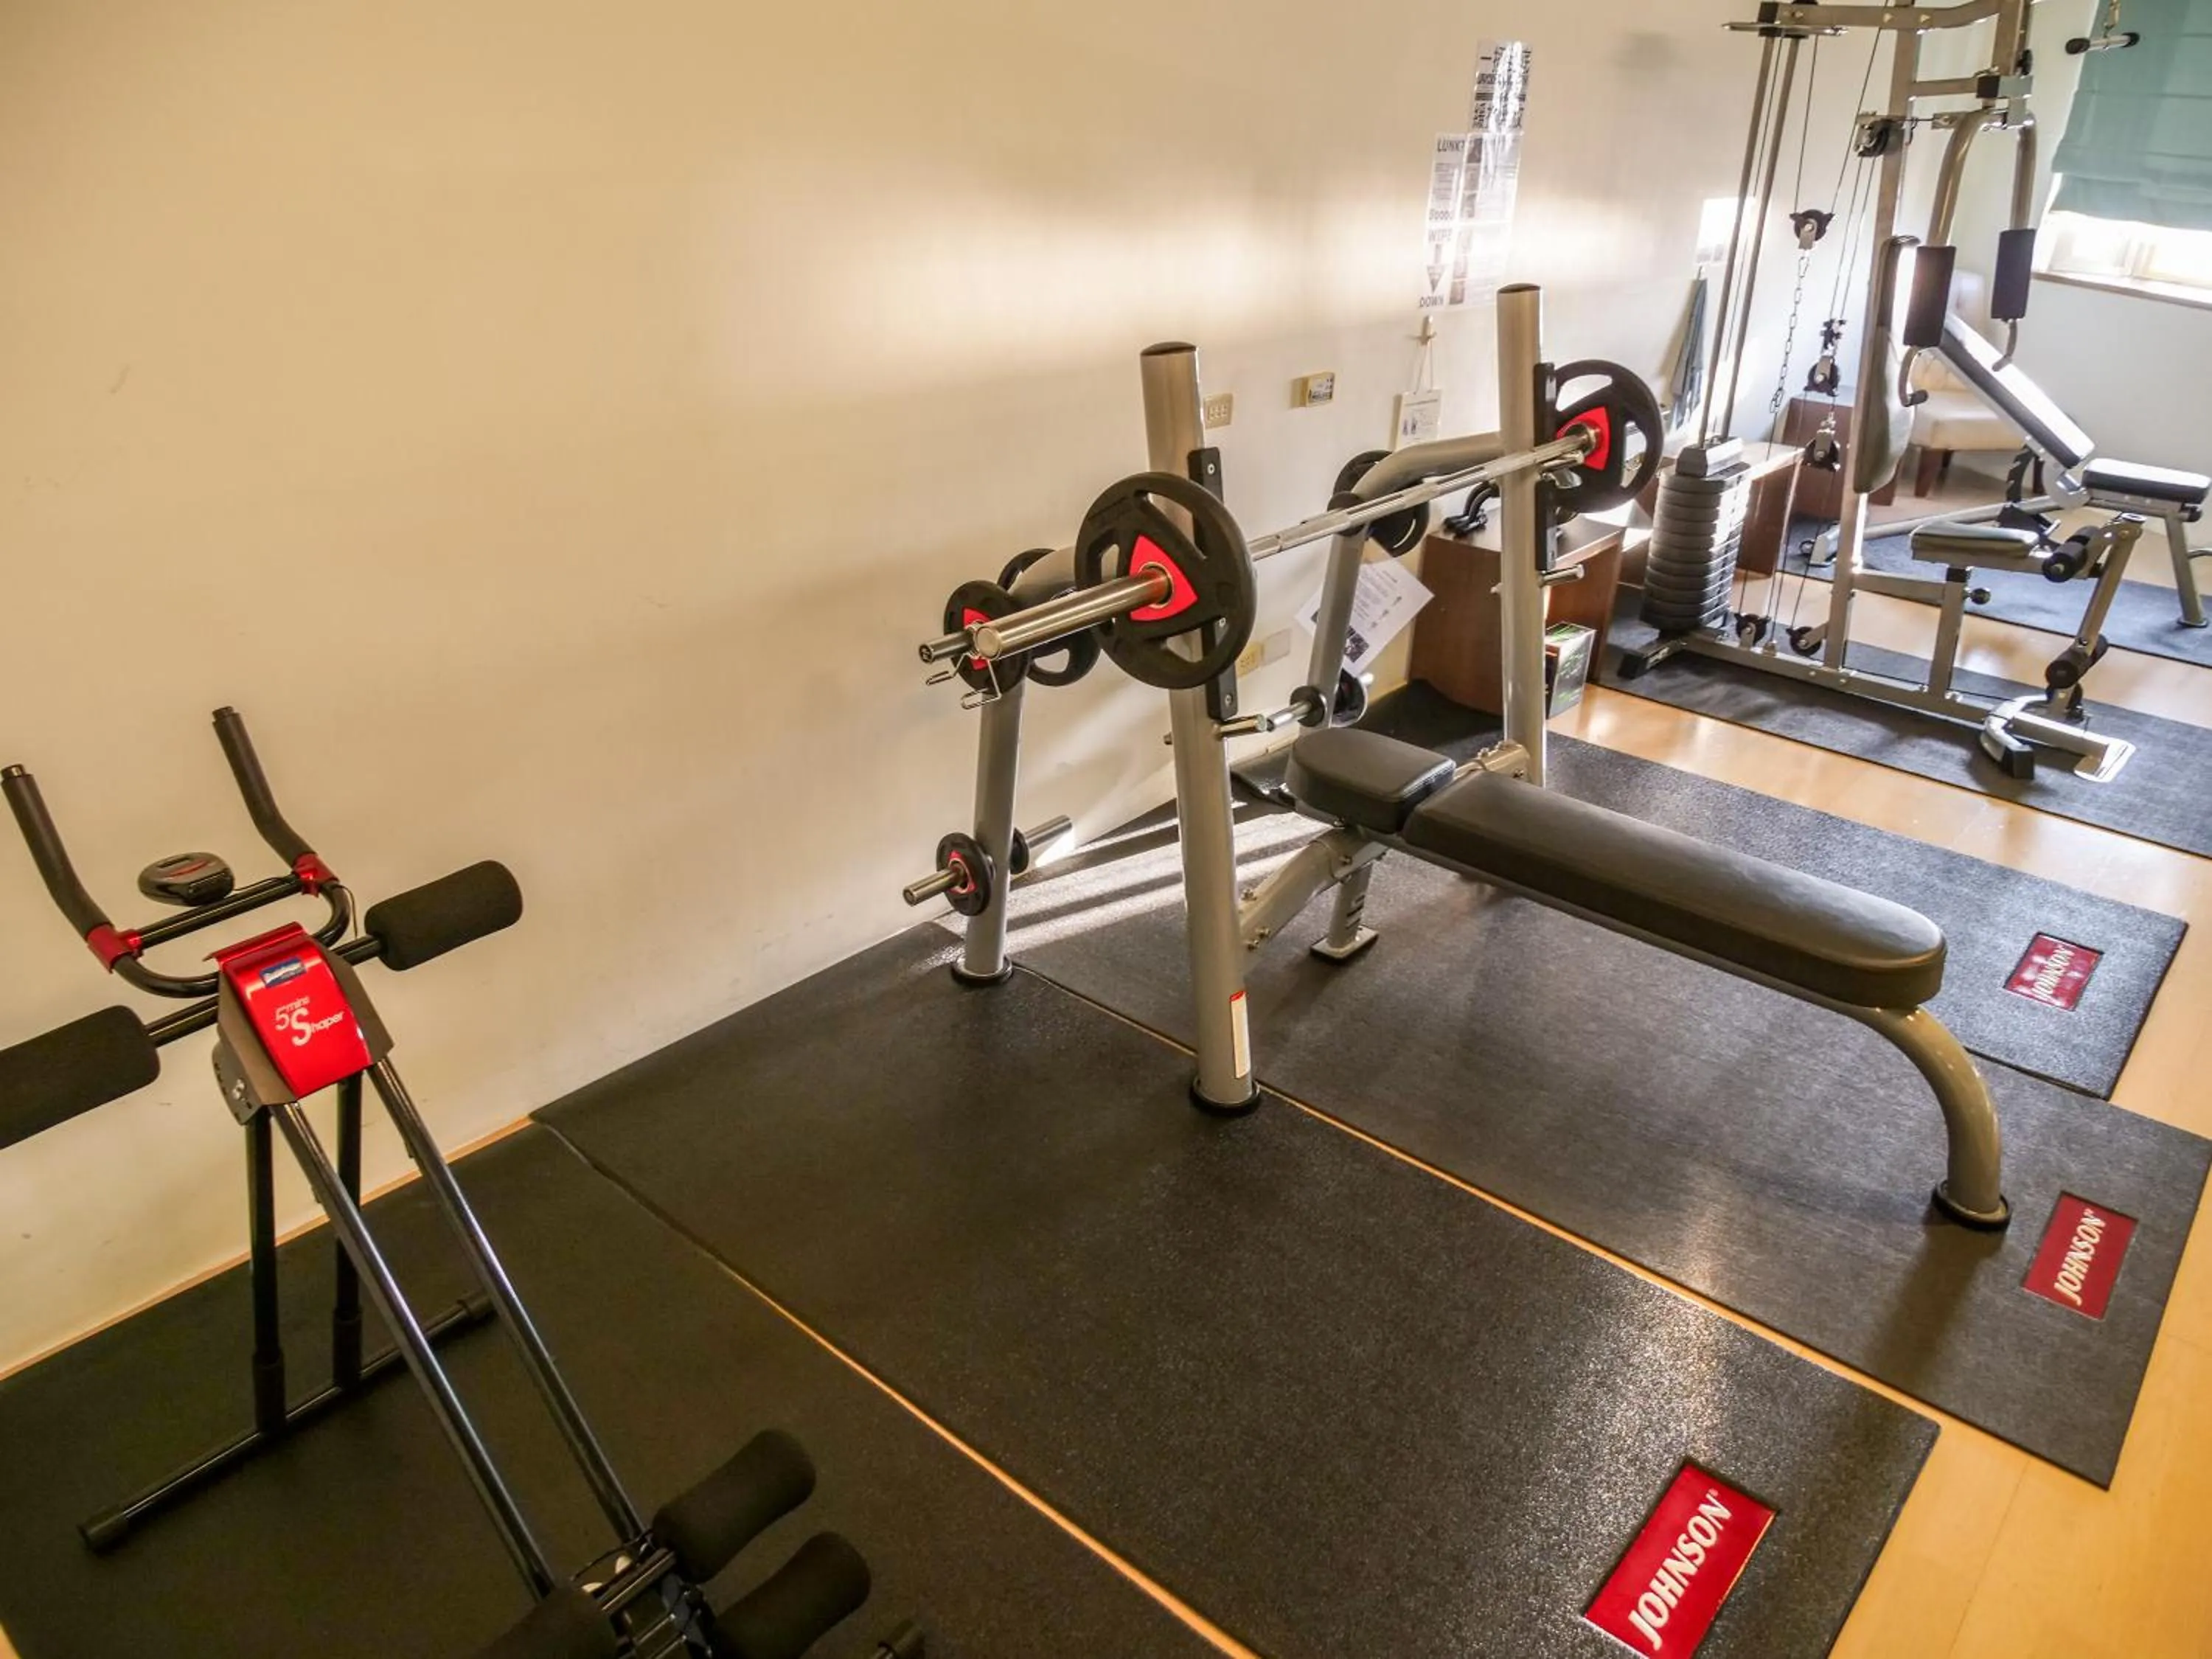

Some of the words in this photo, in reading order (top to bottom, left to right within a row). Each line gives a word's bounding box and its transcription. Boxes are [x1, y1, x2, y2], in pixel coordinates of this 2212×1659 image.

[2031, 947, 2076, 1005] JOHNSON
[2053, 1210, 2106, 1307] JOHNSON
[1628, 1490, 1732, 1651] JOHNSON
